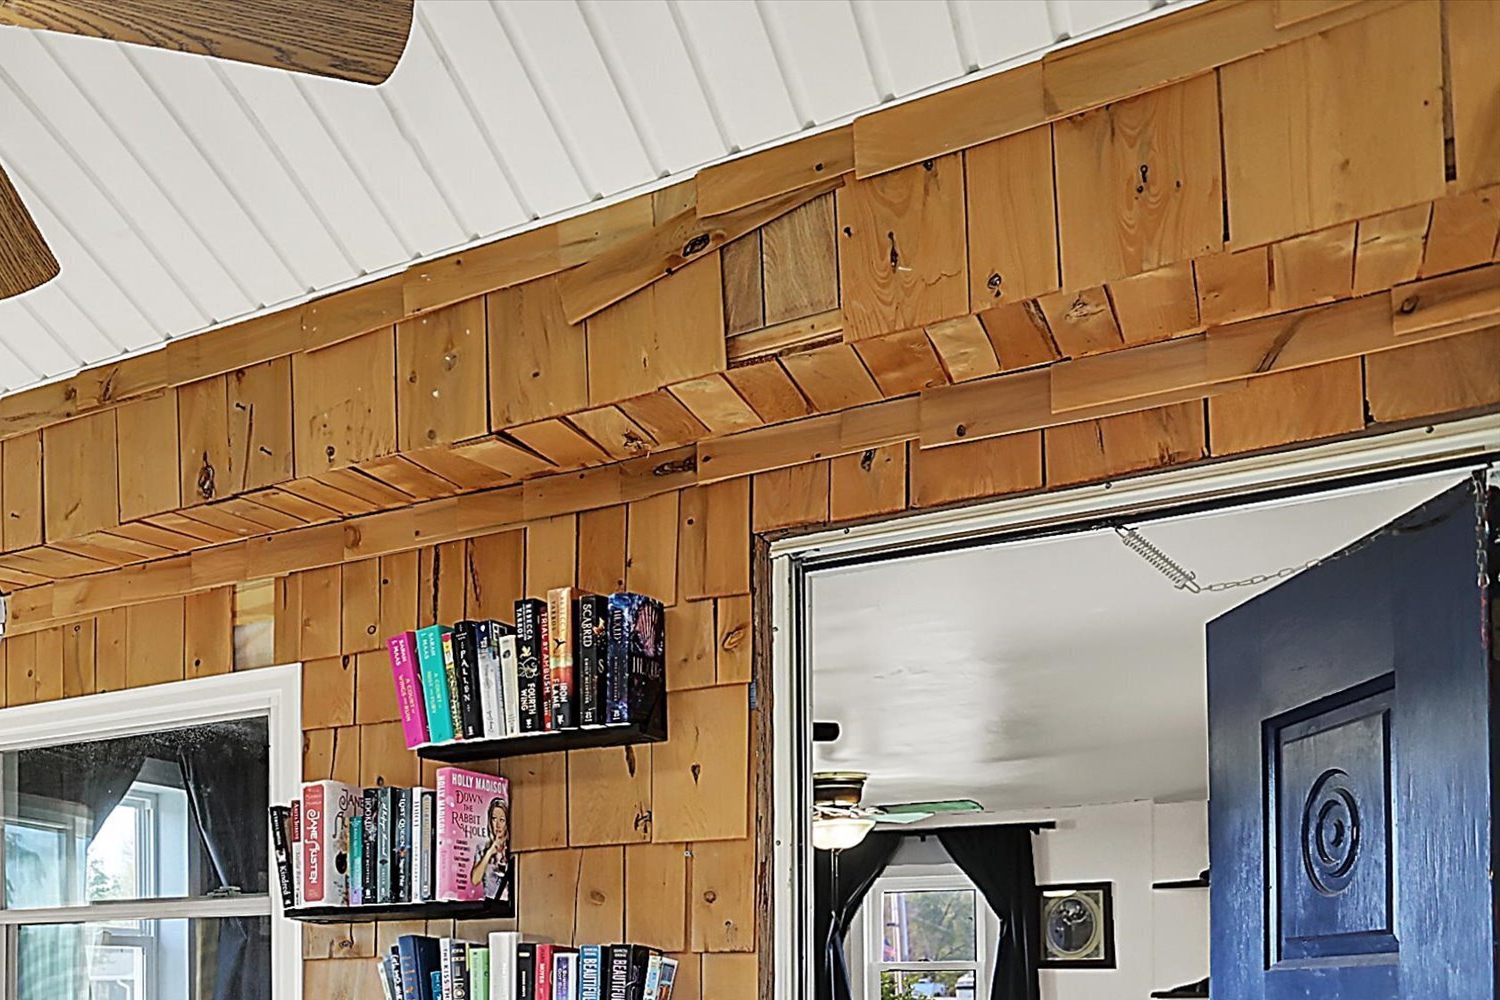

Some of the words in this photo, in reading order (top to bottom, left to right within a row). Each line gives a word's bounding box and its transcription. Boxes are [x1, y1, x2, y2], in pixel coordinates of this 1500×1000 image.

[543, 642, 548, 651] BY
[542, 654, 551, 695] AMBUSH
[521, 689, 529, 711] WING
[528, 683, 536, 715] FOURTH
[552, 678, 560, 708] FLAME
[560, 683, 568, 702] IRON
[452, 773, 473, 788] HOLLY
[475, 777, 508, 795] MADISON
[456, 790, 483, 804] DOWN
[463, 804, 473, 812] THE
[306, 809, 320, 839] JANE
[452, 812, 481, 827] RABBIT
[465, 826, 486, 838] HOLE
[305, 839, 320, 883] AUSTEN
[279, 865, 291, 895] Kindred
[442, 964, 451, 984] KISS
